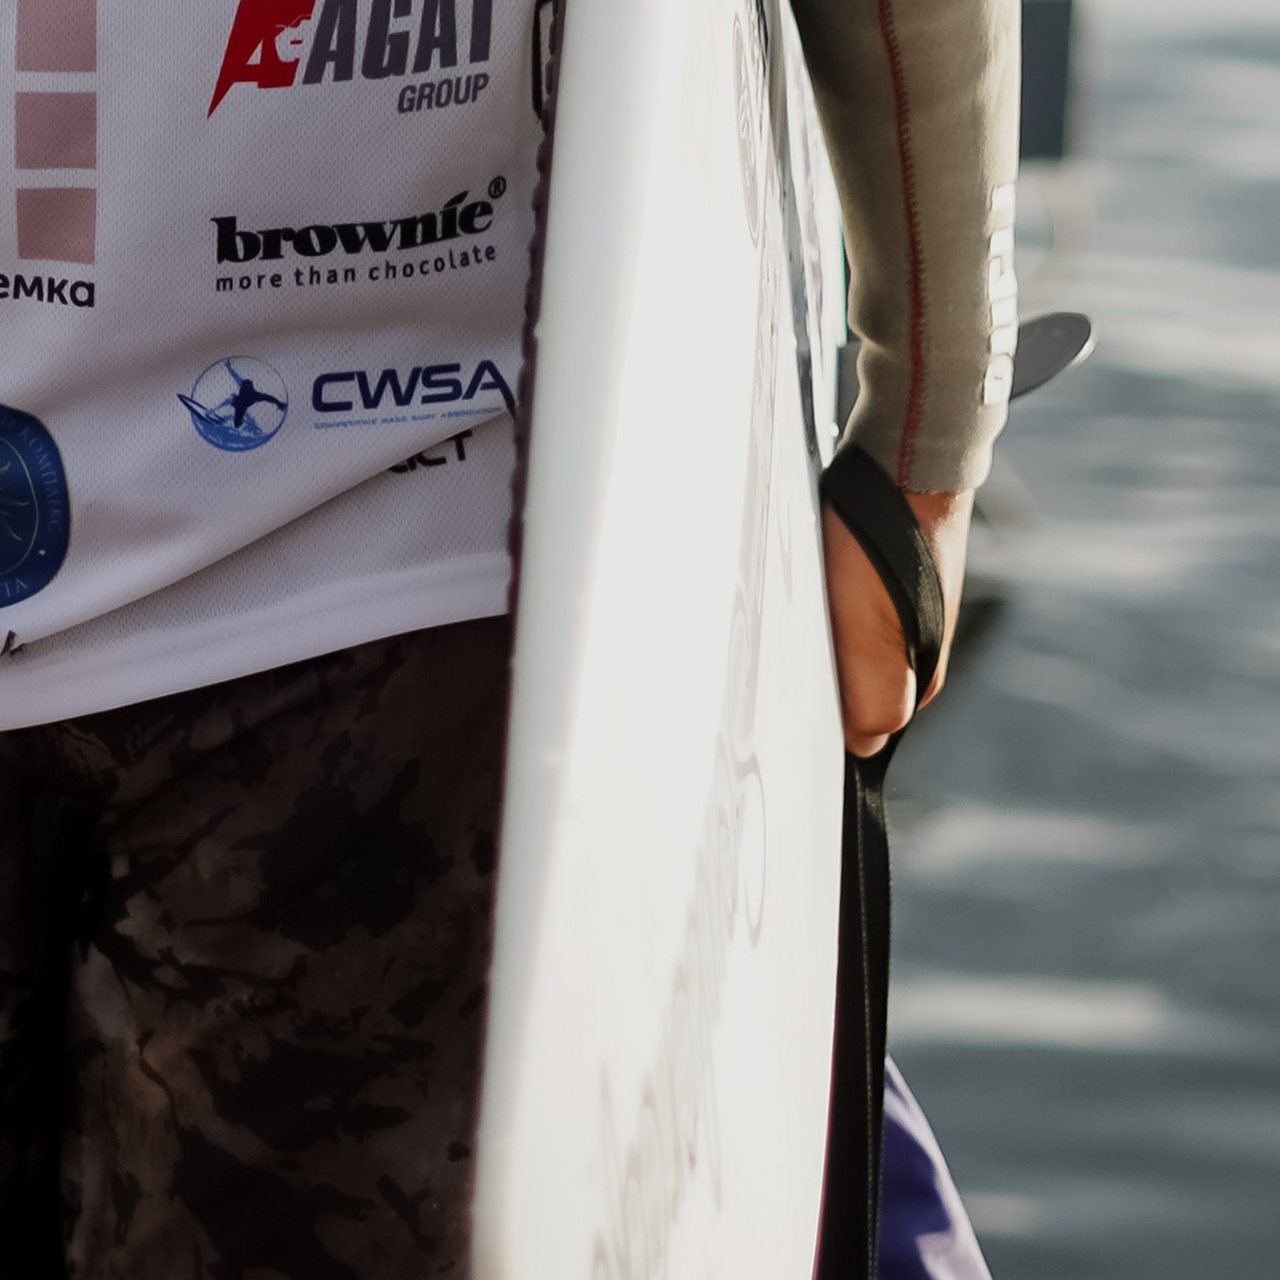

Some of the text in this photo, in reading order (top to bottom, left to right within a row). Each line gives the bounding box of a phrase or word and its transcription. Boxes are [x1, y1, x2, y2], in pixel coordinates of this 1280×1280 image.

[397, 72, 490, 115] GROUP
[215, 244, 496, 292] more than chocolate
[311, 358, 517, 415] CWSA
